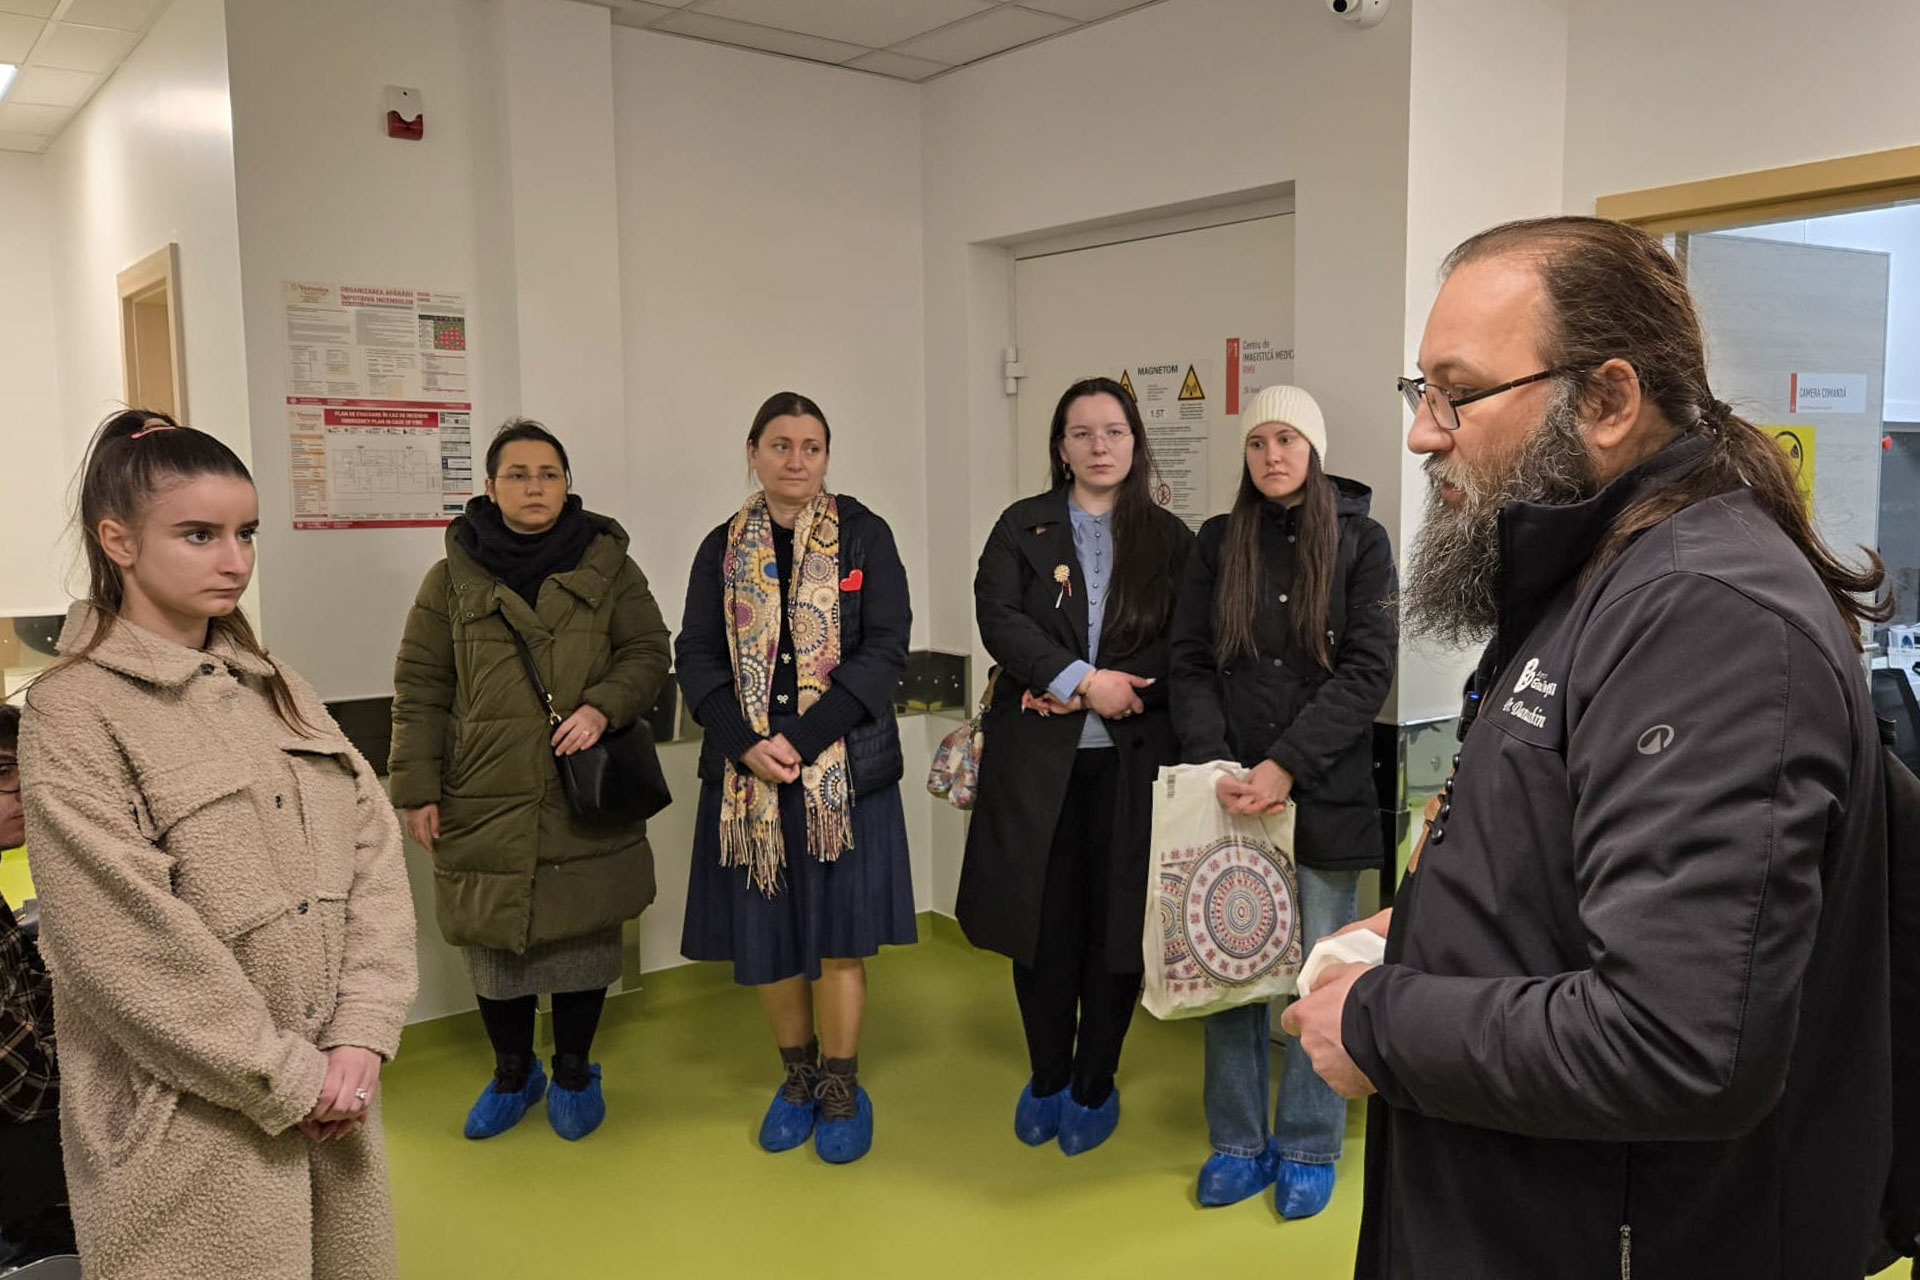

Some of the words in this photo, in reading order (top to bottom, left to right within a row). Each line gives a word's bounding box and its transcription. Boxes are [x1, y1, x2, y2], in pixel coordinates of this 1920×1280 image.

[1262, 339, 1270, 348] de
[1138, 365, 1179, 376] MAGNETOM
[1799, 387, 1820, 398] CAMERA
